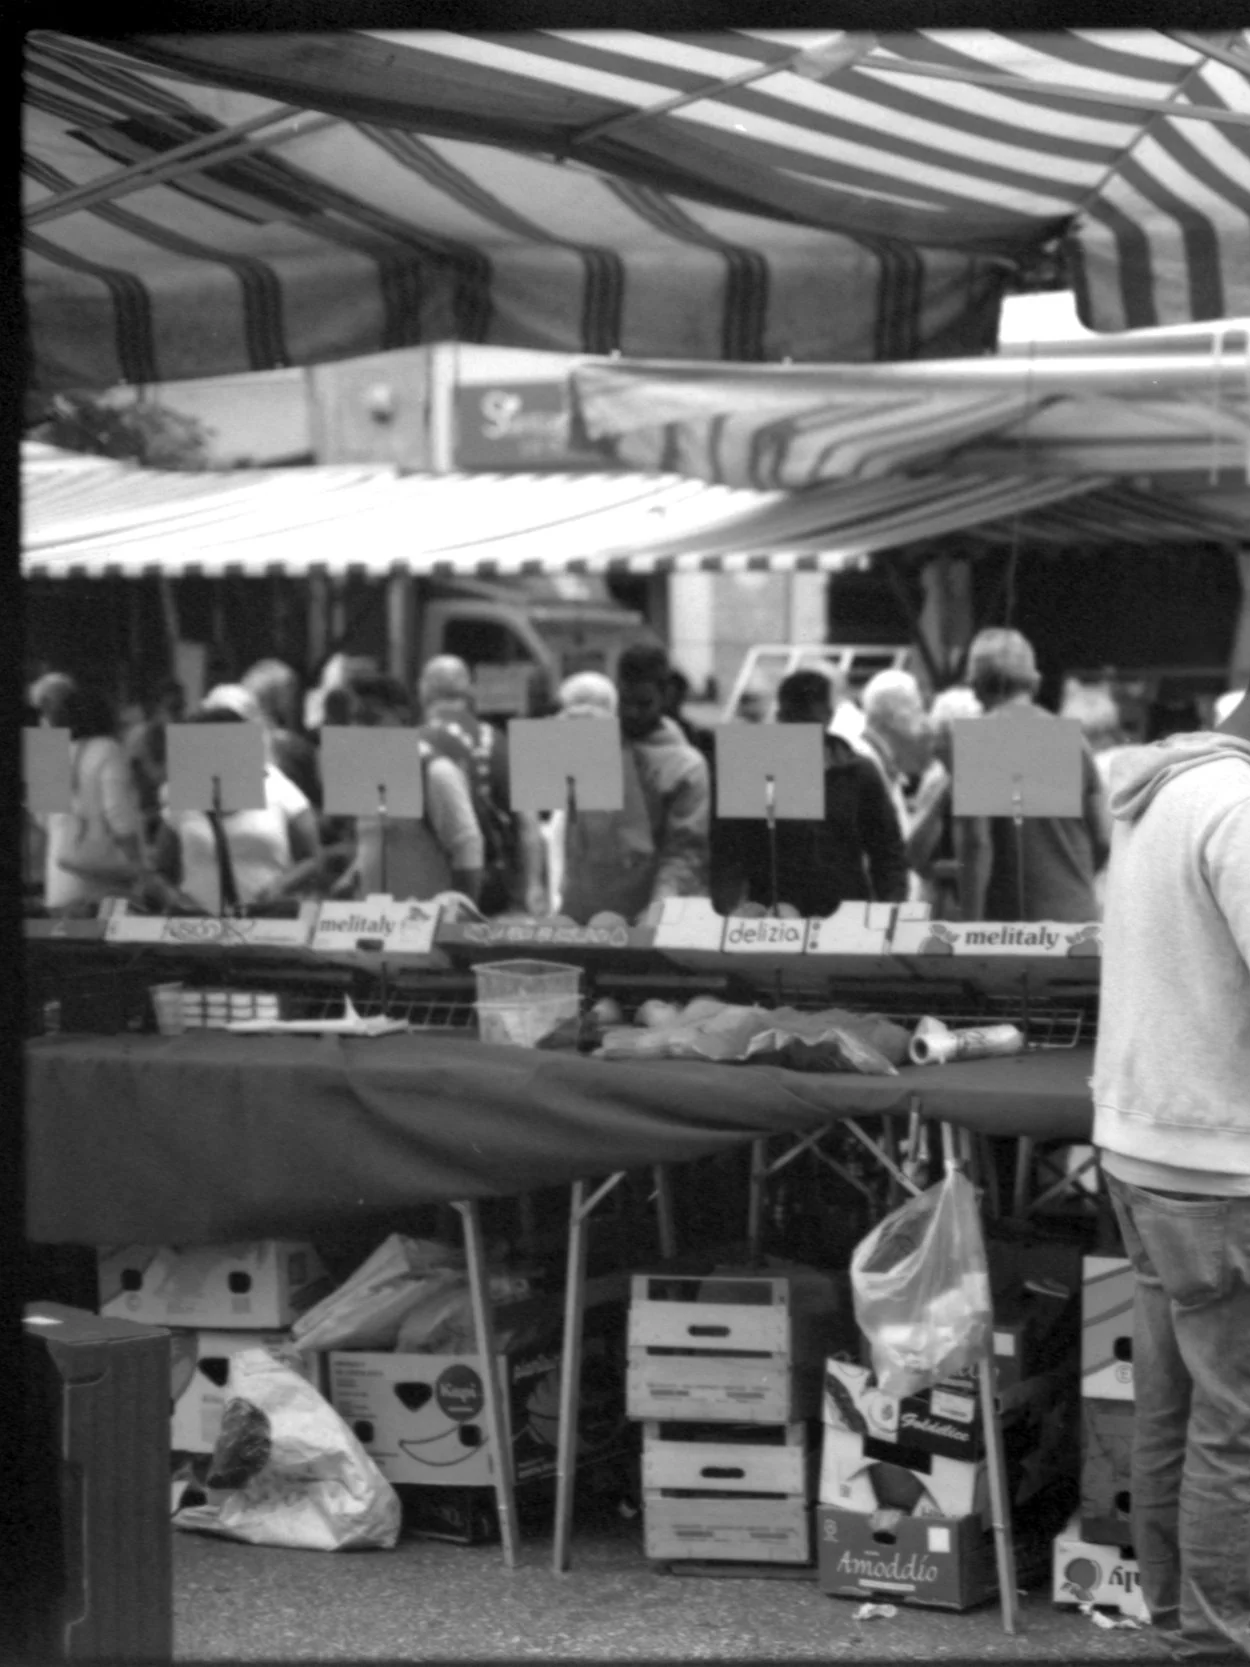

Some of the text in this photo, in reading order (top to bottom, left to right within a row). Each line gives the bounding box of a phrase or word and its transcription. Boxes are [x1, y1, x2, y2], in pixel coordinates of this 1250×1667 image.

[319, 914, 396, 937] melitaly
[728, 920, 799, 944] delizia
[964, 926, 1059, 950] melitaly
